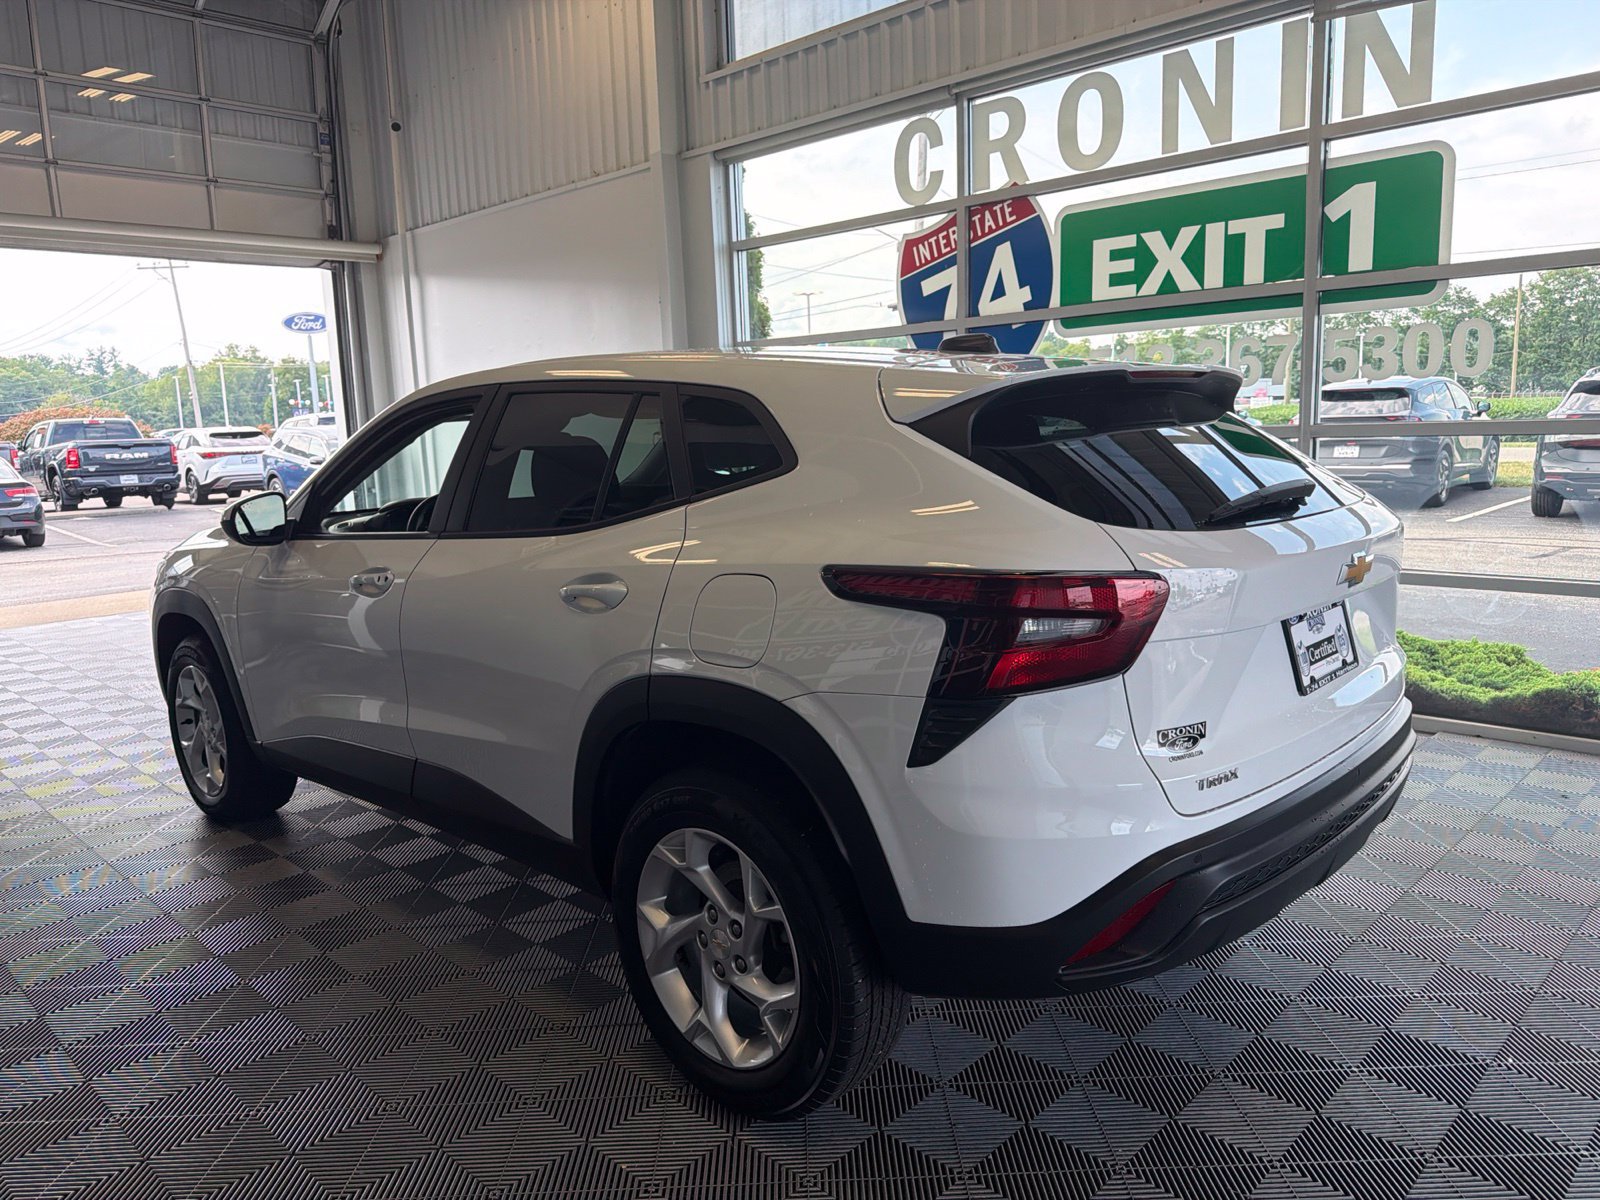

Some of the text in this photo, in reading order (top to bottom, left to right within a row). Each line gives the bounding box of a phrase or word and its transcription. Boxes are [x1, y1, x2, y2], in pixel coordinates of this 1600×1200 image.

[895, 0, 1436, 207] CRONIN
[1092, 181, 1377, 301] EXIT 1
[921, 241, 1032, 338] 74
[291, 315, 323, 330] Ford
[105, 452, 149, 460] RAM
[1308, 638, 1337, 662] Certified
[1158, 722, 1206, 744] CRONIN
[1174, 737, 1194, 750] Ford
[1195, 767, 1239, 791] TRAX
